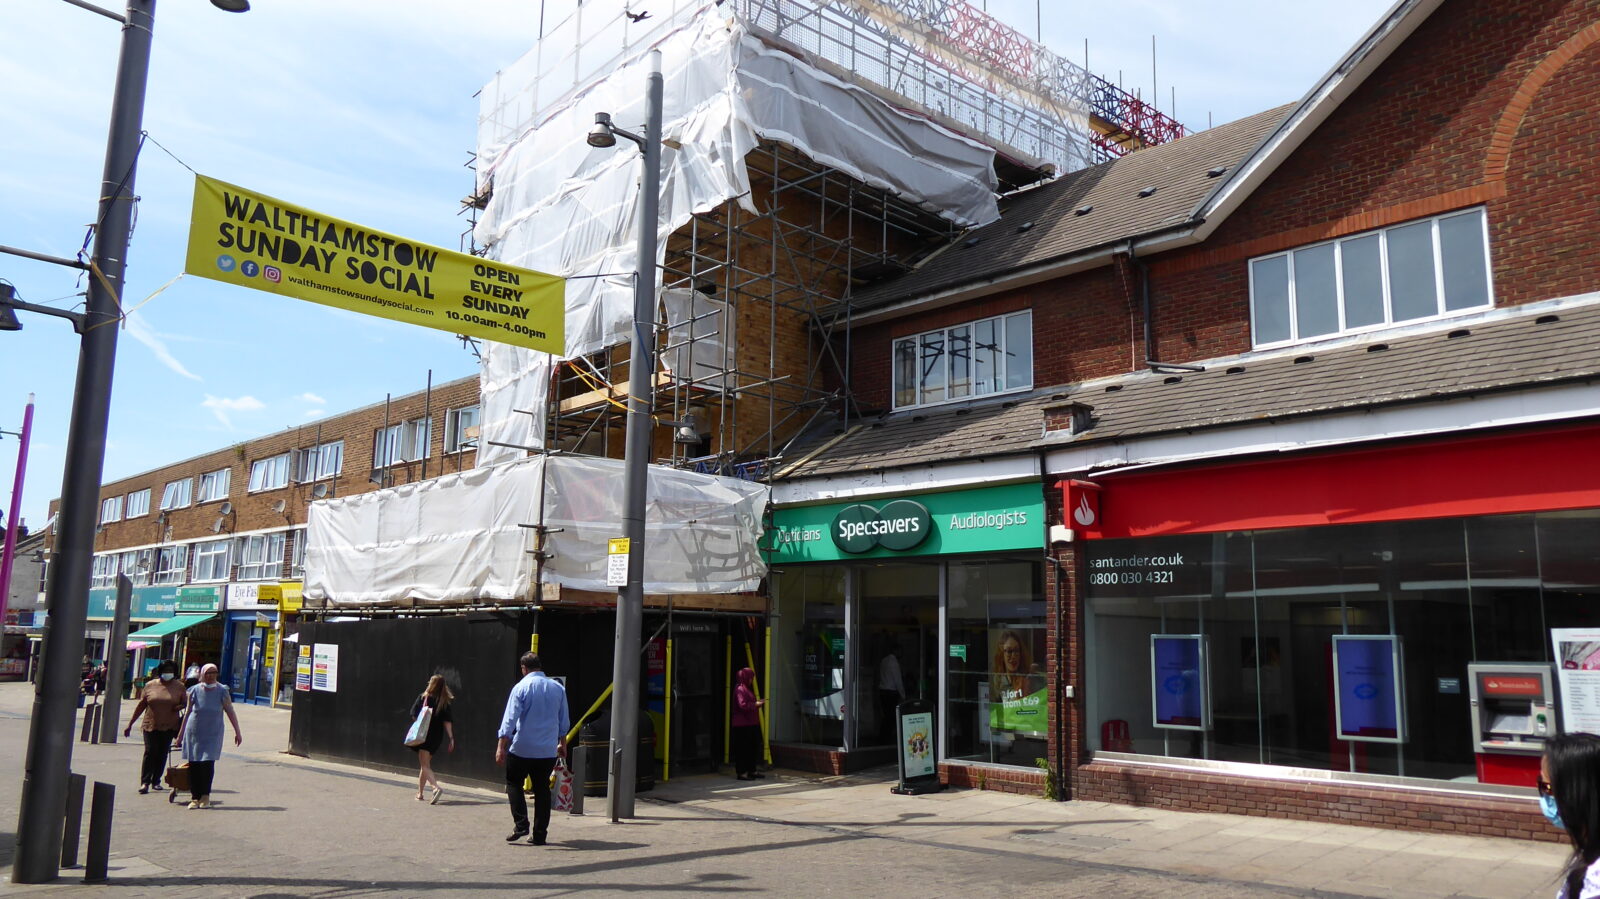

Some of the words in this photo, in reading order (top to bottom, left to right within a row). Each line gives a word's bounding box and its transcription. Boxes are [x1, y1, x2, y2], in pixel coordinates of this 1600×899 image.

[223, 191, 439, 273] WALTHAMSTOW
[217, 221, 338, 275] SUNDAY
[345, 255, 435, 300] SOCIAL
[473, 264, 520, 286] OPEN
[287, 274, 434, 317] walthamstowsundaysocial.com
[469, 279, 524, 303] EVERY
[461, 294, 530, 320] SUNDAY
[445, 310, 546, 340] 10.00am-4.00pm
[839, 516, 919, 541] Specsavers
[949, 508, 1027, 532] Audiologists
[777, 527, 821, 543] Opticians
[1090, 553, 1183, 568] santander.co.uk
[1090, 572, 1118, 585] 0800
[1121, 572, 1142, 584] 030
[1146, 571, 1174, 583] 4321
[235, 585, 245, 600] Eye
